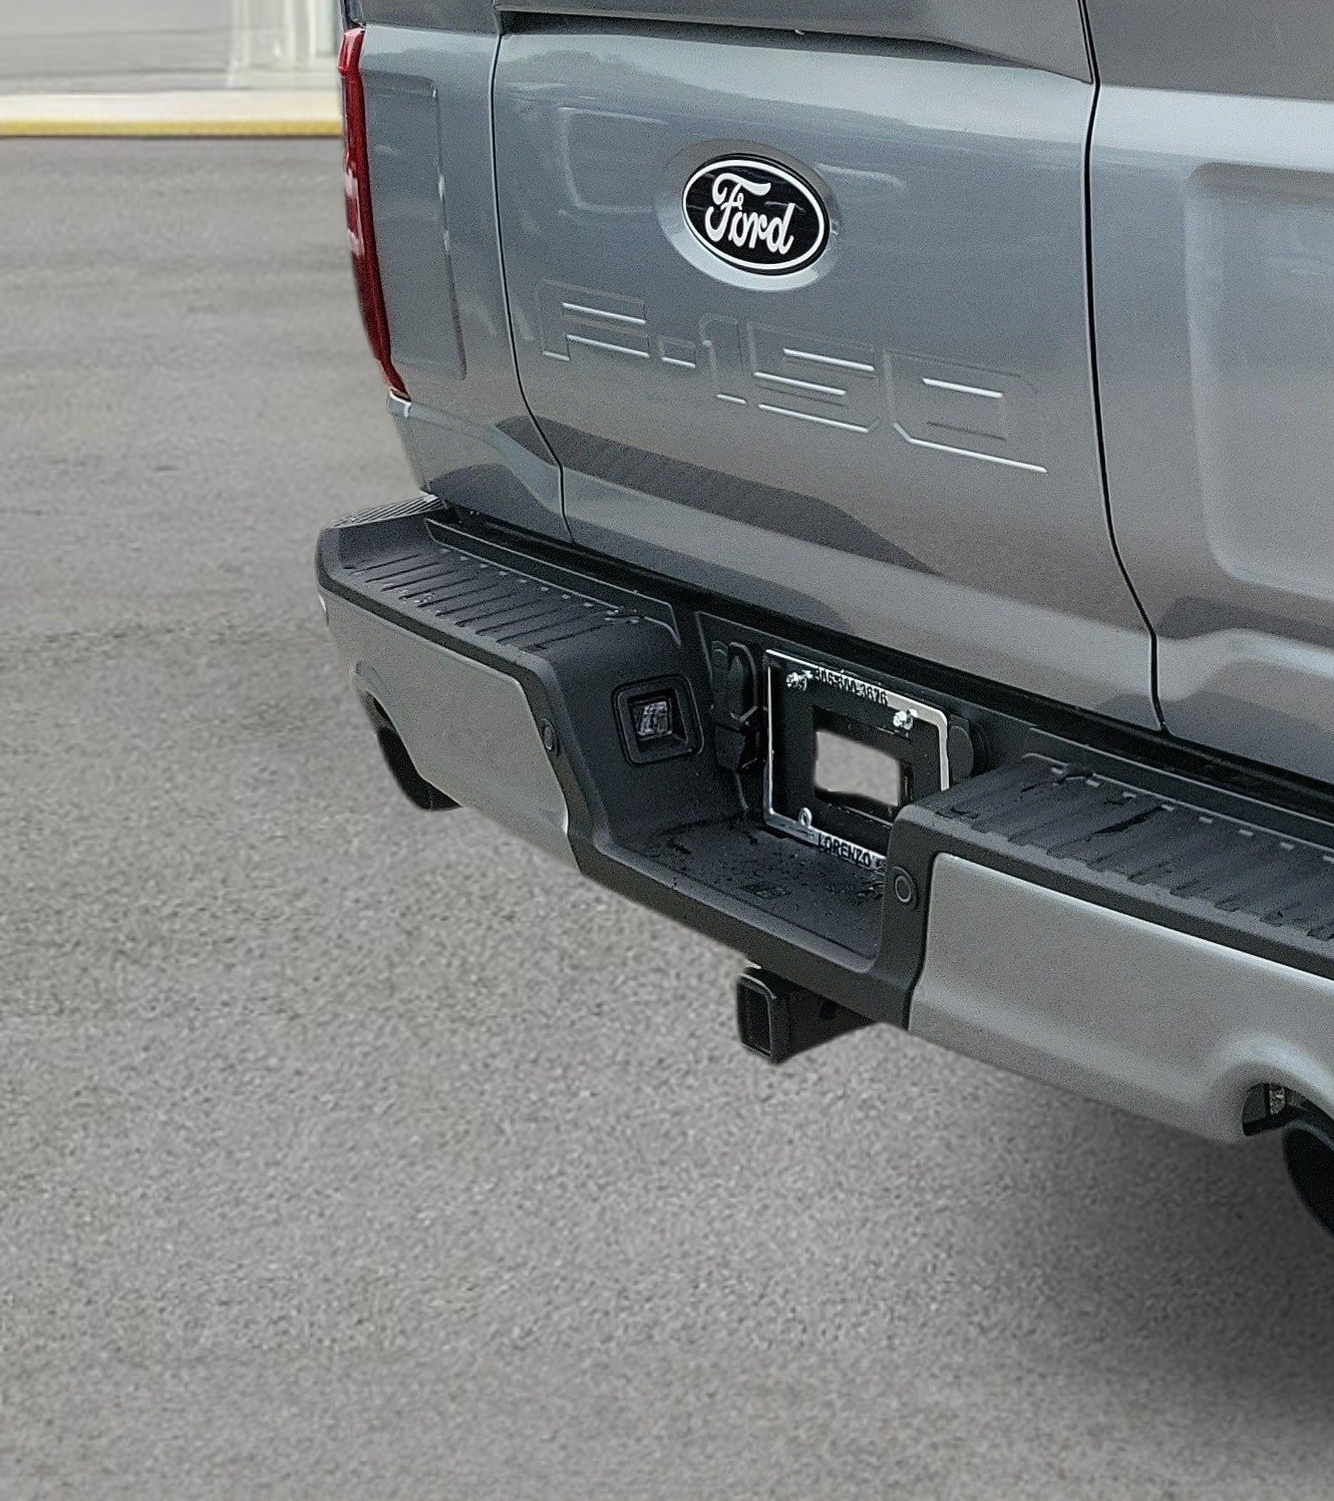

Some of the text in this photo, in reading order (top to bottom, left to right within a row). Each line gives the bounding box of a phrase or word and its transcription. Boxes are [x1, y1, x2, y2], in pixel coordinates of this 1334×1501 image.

[704, 172, 795, 255] Ford
[538, 277, 1048, 474] F-150
[817, 831, 872, 869] LORENZO
